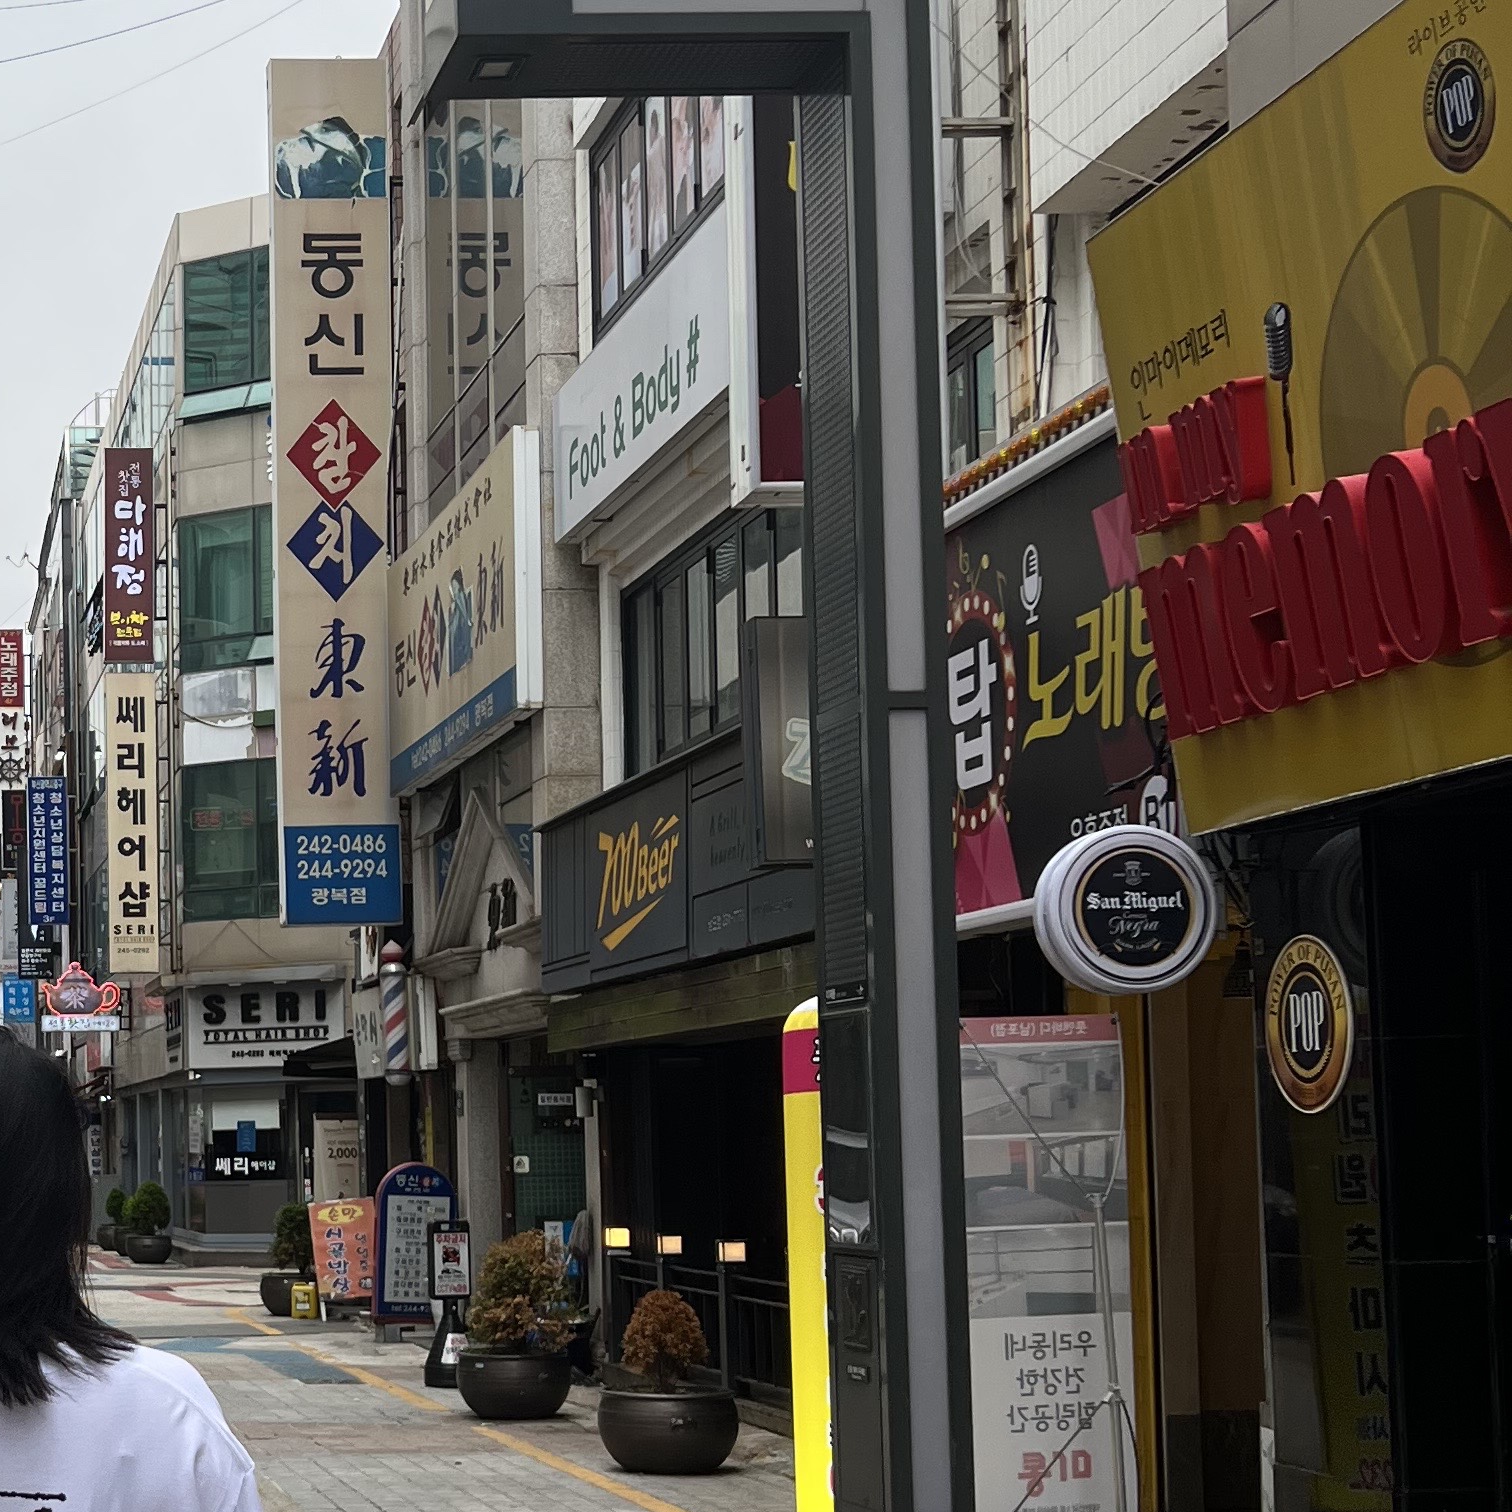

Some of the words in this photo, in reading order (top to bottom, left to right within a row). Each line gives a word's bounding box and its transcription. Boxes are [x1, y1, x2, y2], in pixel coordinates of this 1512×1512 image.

[1442, 74, 1474, 134] POP
[567, 408, 607, 500] Foot
[613, 394, 627, 459] &
[631, 345, 680, 441] Body
[111, 495, 147, 595] 다해정
[1138, 398, 1512, 742] memor
[0, 637, 18, 697] 노래주점
[308, 618, 367, 798] 東新
[947, 638, 998, 791] 탑
[116, 696, 150, 917] 쎄리헤어샵
[297, 834, 386, 854] 242-0486
[297, 859, 388, 879] 244-9294
[311, 887, 366, 905] 광복점
[1087, 892, 1121, 909] San
[1122, 890, 1184, 912] Miguel
[114, 925, 155, 936] SERI
[1297, 944, 1314, 962] OF
[60, 985, 88, 1009] 茶
[203, 988, 326, 1025] SERI
[1289, 990, 1326, 1053] POP
[215, 1157, 249, 1176] 쎄리
[327, 1147, 358, 1160] 2,000
